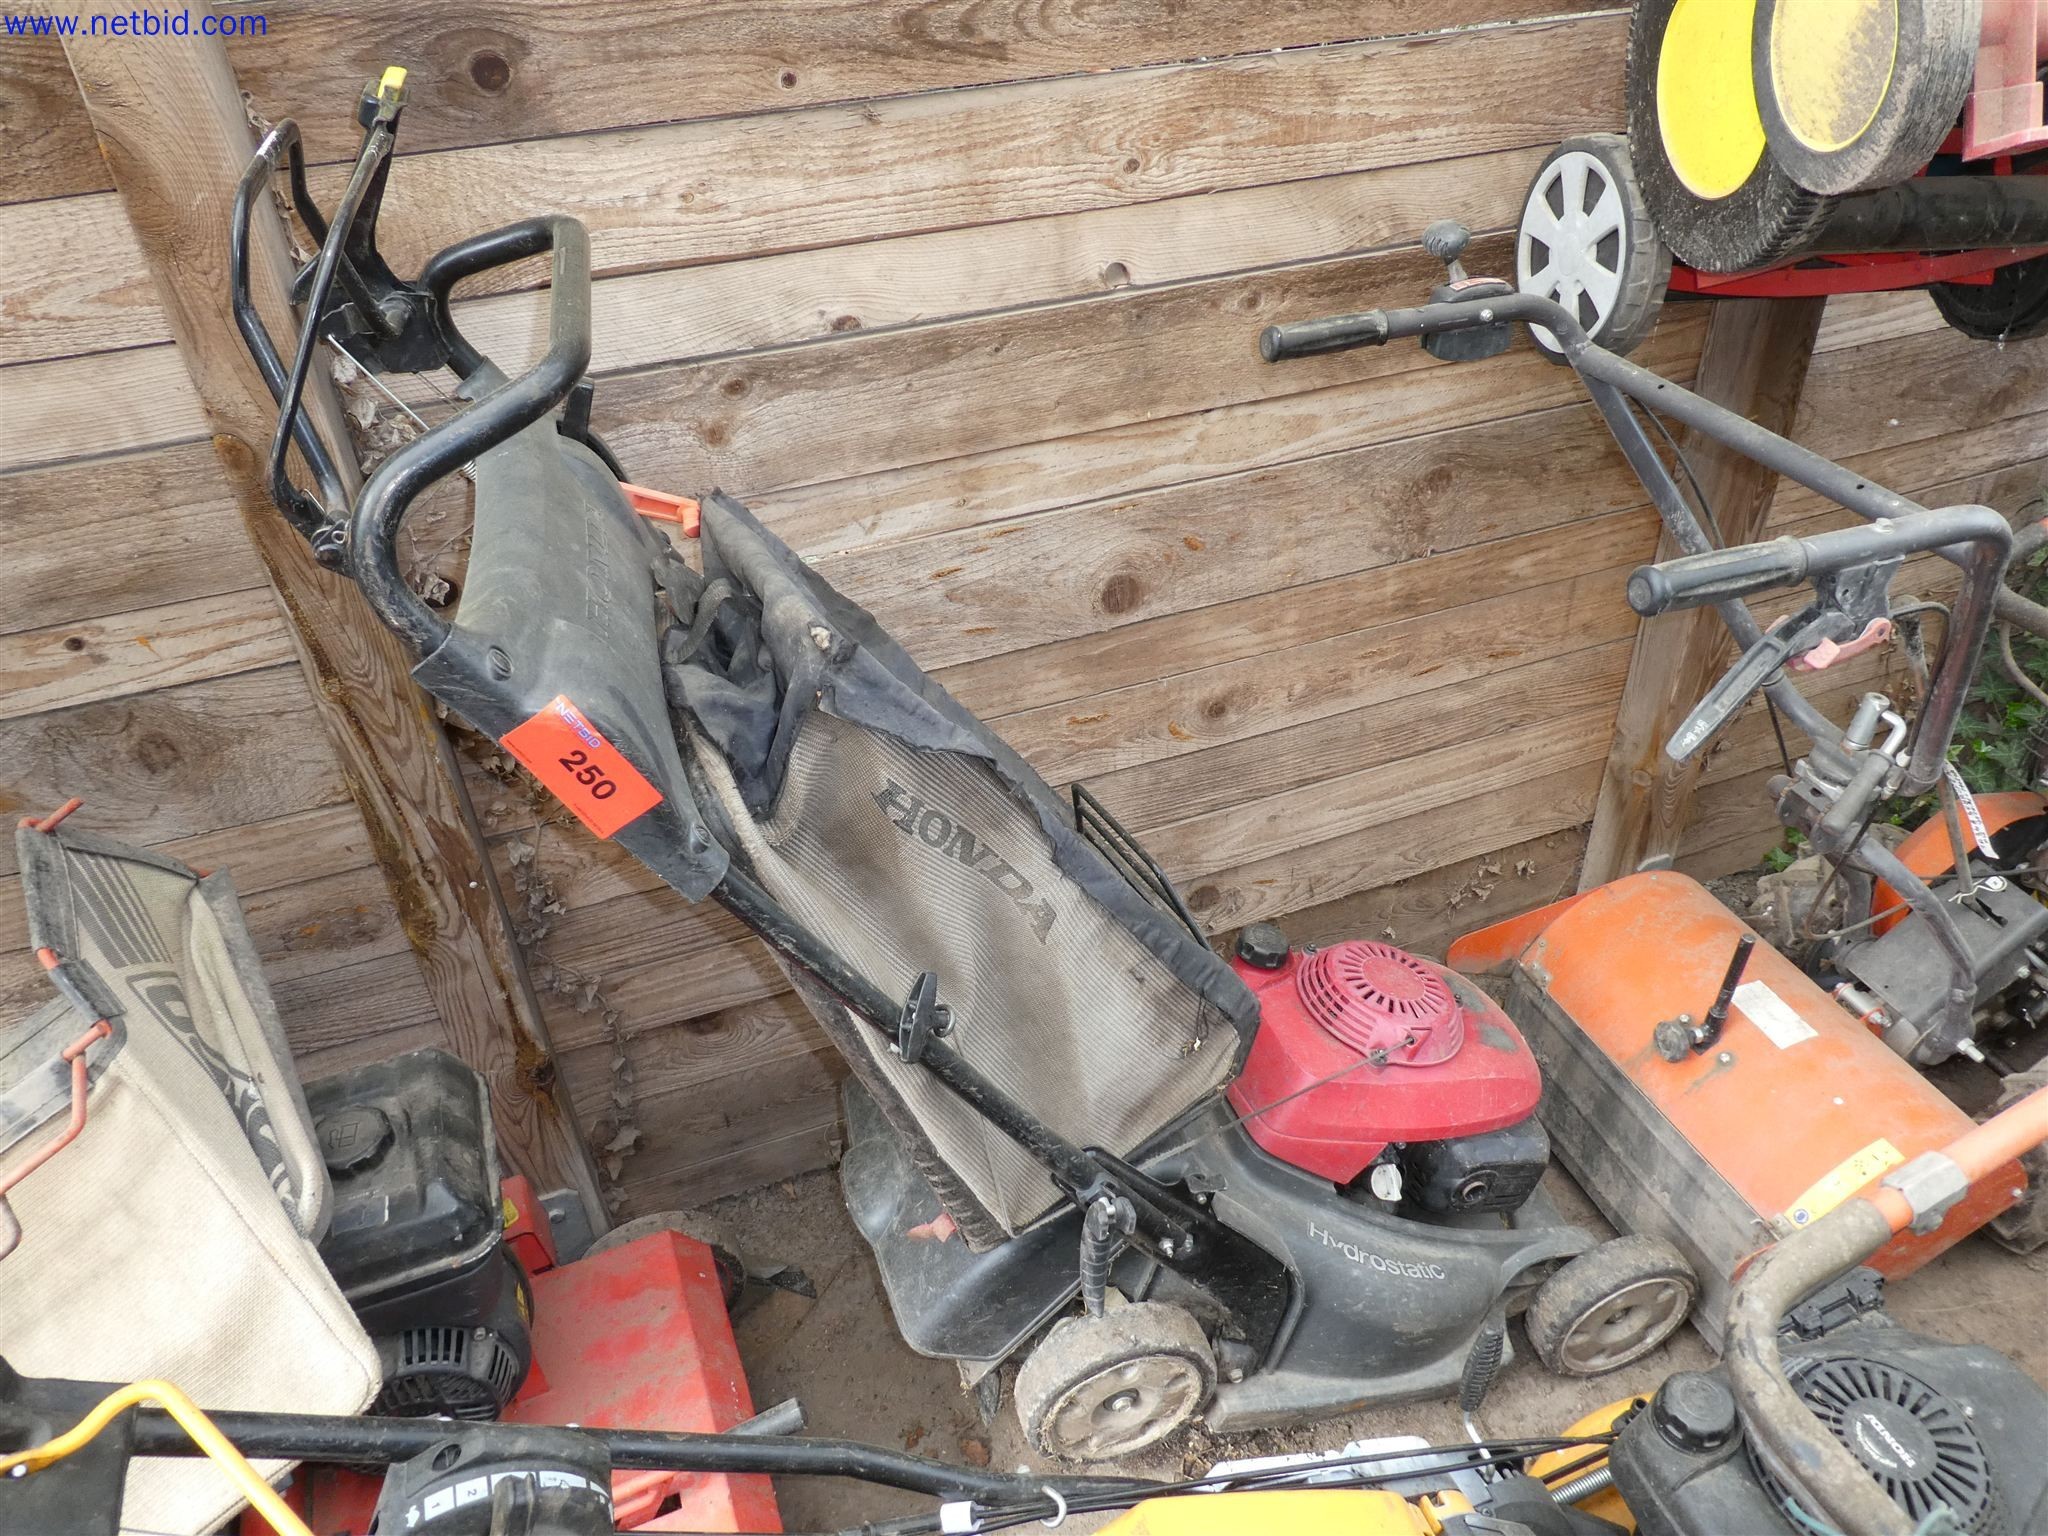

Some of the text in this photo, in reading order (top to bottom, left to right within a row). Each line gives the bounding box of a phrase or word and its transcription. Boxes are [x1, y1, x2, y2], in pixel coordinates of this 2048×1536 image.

[555, 702, 601, 749] NETBID
[558, 750, 617, 800] 250
[870, 777, 1057, 946] HONDA
[1308, 1221, 1446, 1280] Hydrostatic
